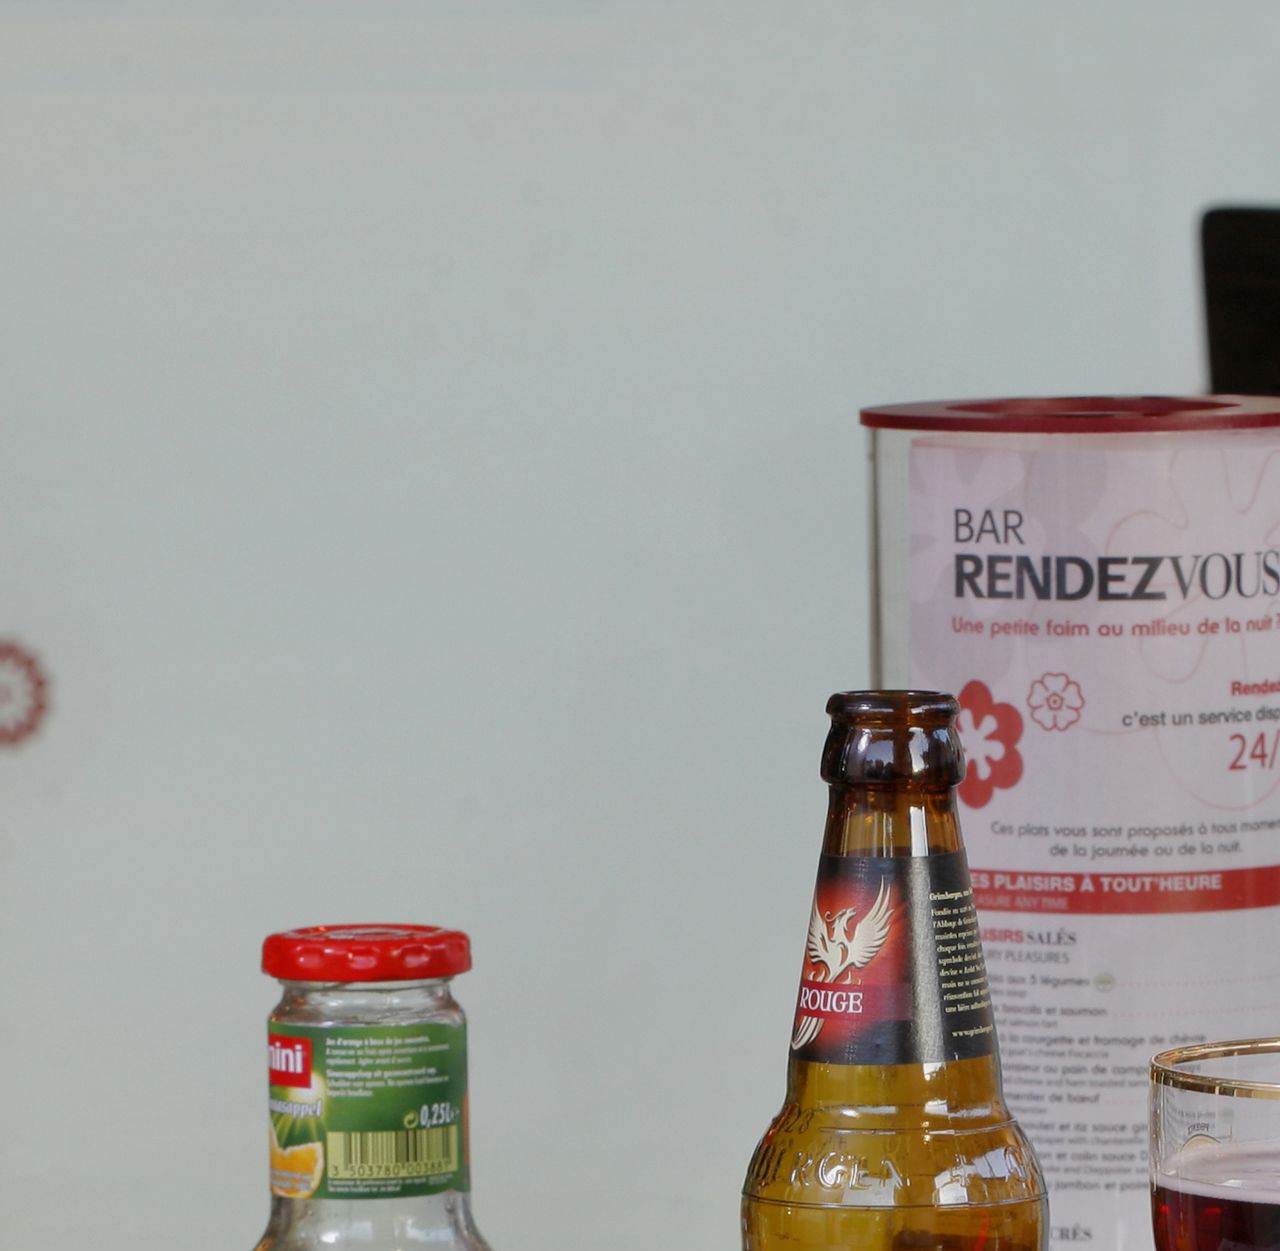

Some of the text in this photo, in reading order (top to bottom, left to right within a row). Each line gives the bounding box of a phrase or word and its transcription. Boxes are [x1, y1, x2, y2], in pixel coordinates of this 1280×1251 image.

[954, 508, 1025, 545] BAR
[951, 616, 984, 634] Une
[990, 618, 1039, 638] petite
[1046, 617, 1089, 636] faim
[1098, 621, 1124, 637] au
[1131, 616, 1190, 637] milieu
[1197, 615, 1219, 634] de
[1225, 616, 1242, 633] la
[1122, 707, 1252, 727] c'est un service
[990, 820, 1014, 836] Ces
[1018, 822, 1049, 840] plats
[1053, 825, 1087, 838] vous
[1092, 822, 1122, 838] sont
[1127, 821, 1194, 841] proposés
[1049, 844, 1069, 857] de
[1072, 844, 1088, 858] la
[1090, 844, 1149, 861] journée
[1178, 843, 1196, 857] de
[1200, 842, 1214, 856] la
[971, 872, 1224, 893] ES PLAISIRS À TOUT'HEURE
[800, 986, 863, 1013] ROUGE
